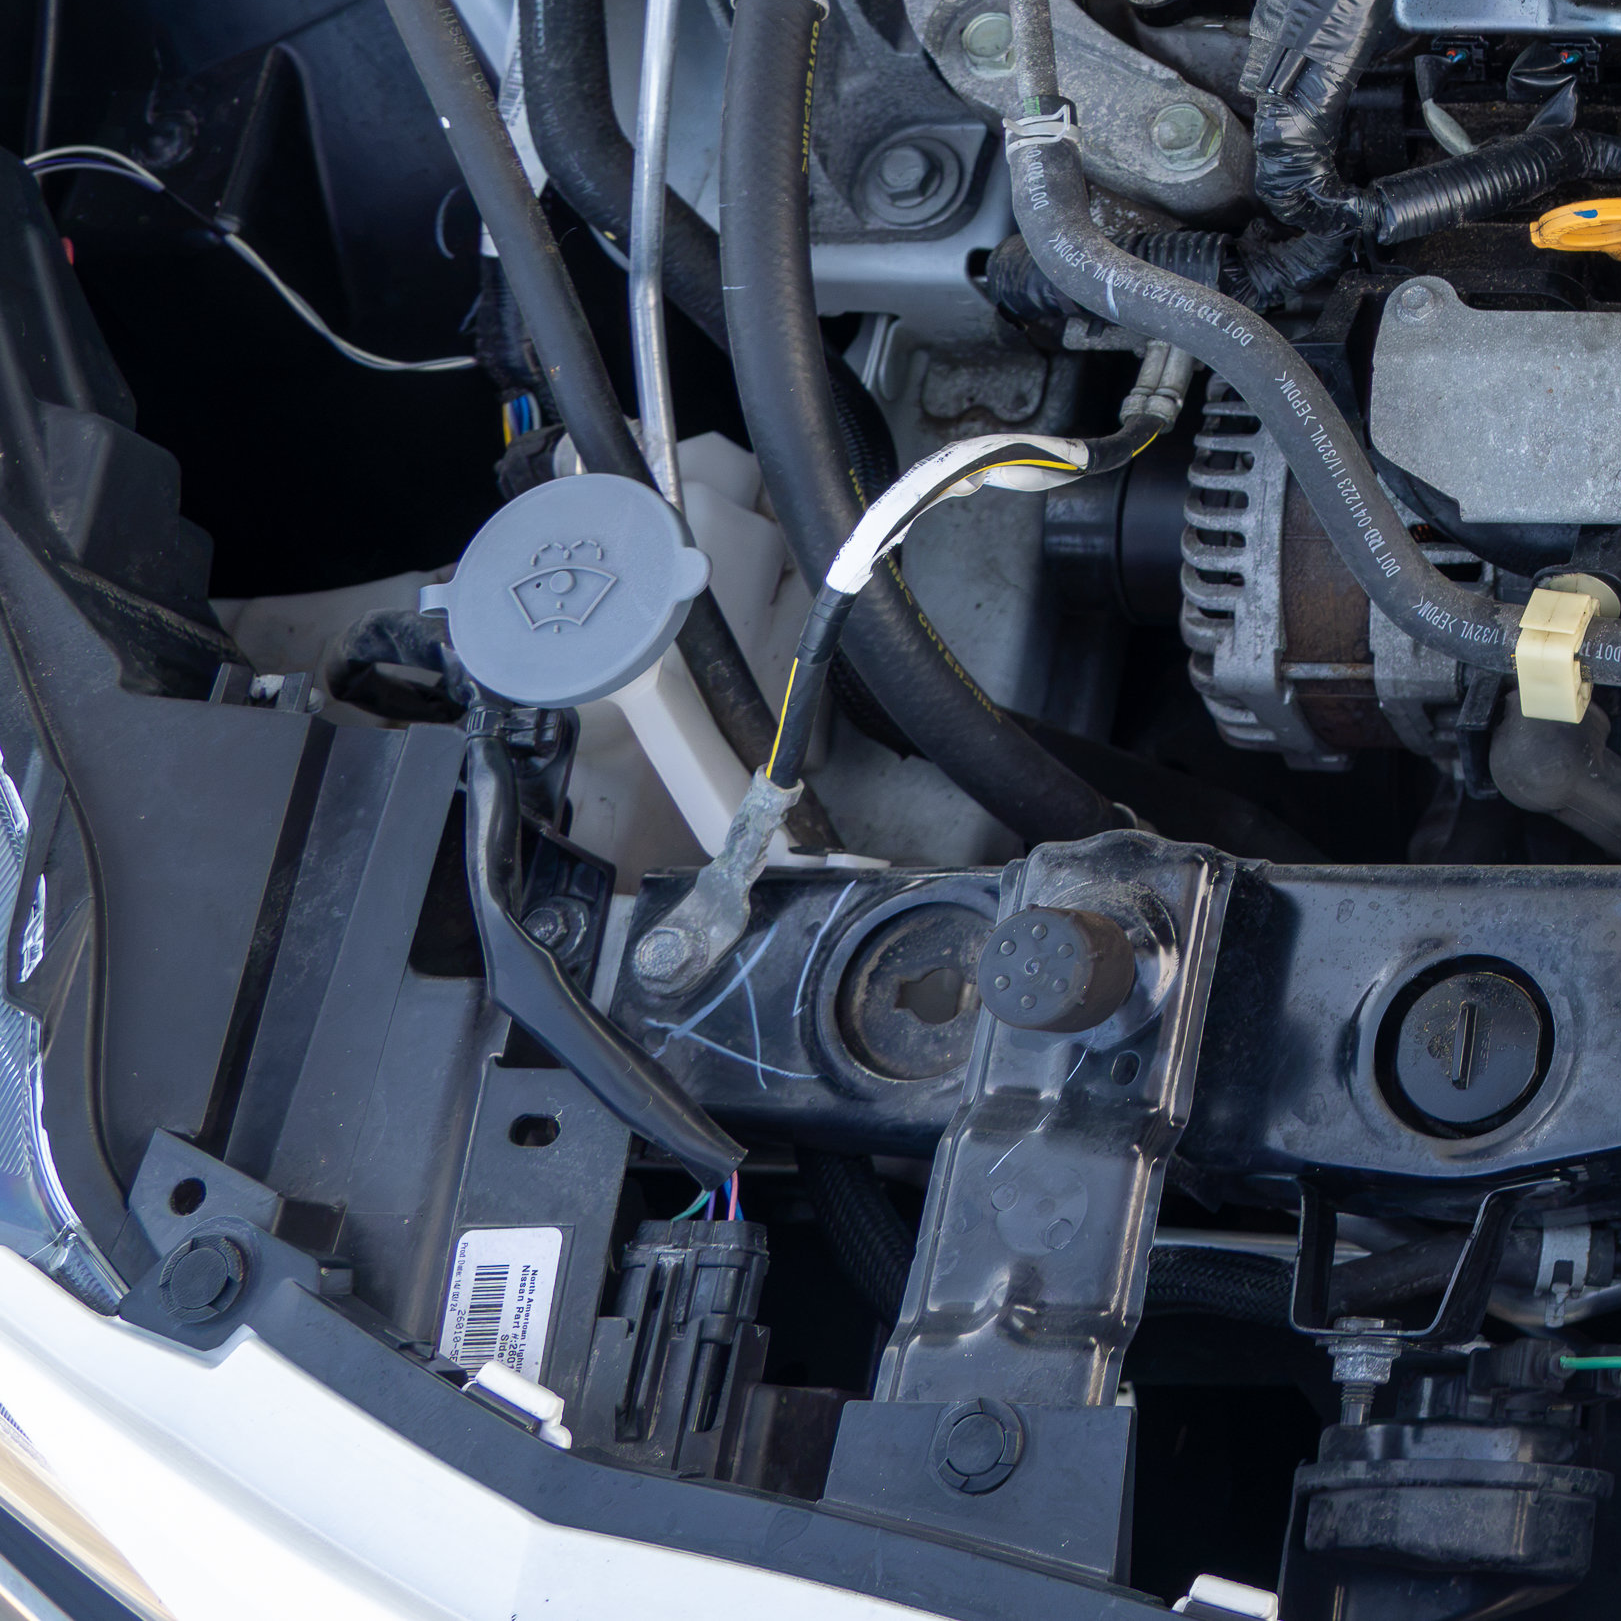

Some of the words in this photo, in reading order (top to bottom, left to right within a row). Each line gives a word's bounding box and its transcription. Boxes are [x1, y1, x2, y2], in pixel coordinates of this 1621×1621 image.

[1376, 552, 1401, 578] DOT
[517, 1264, 531, 1302] Nissan
[512, 1306, 524, 1330] Part
